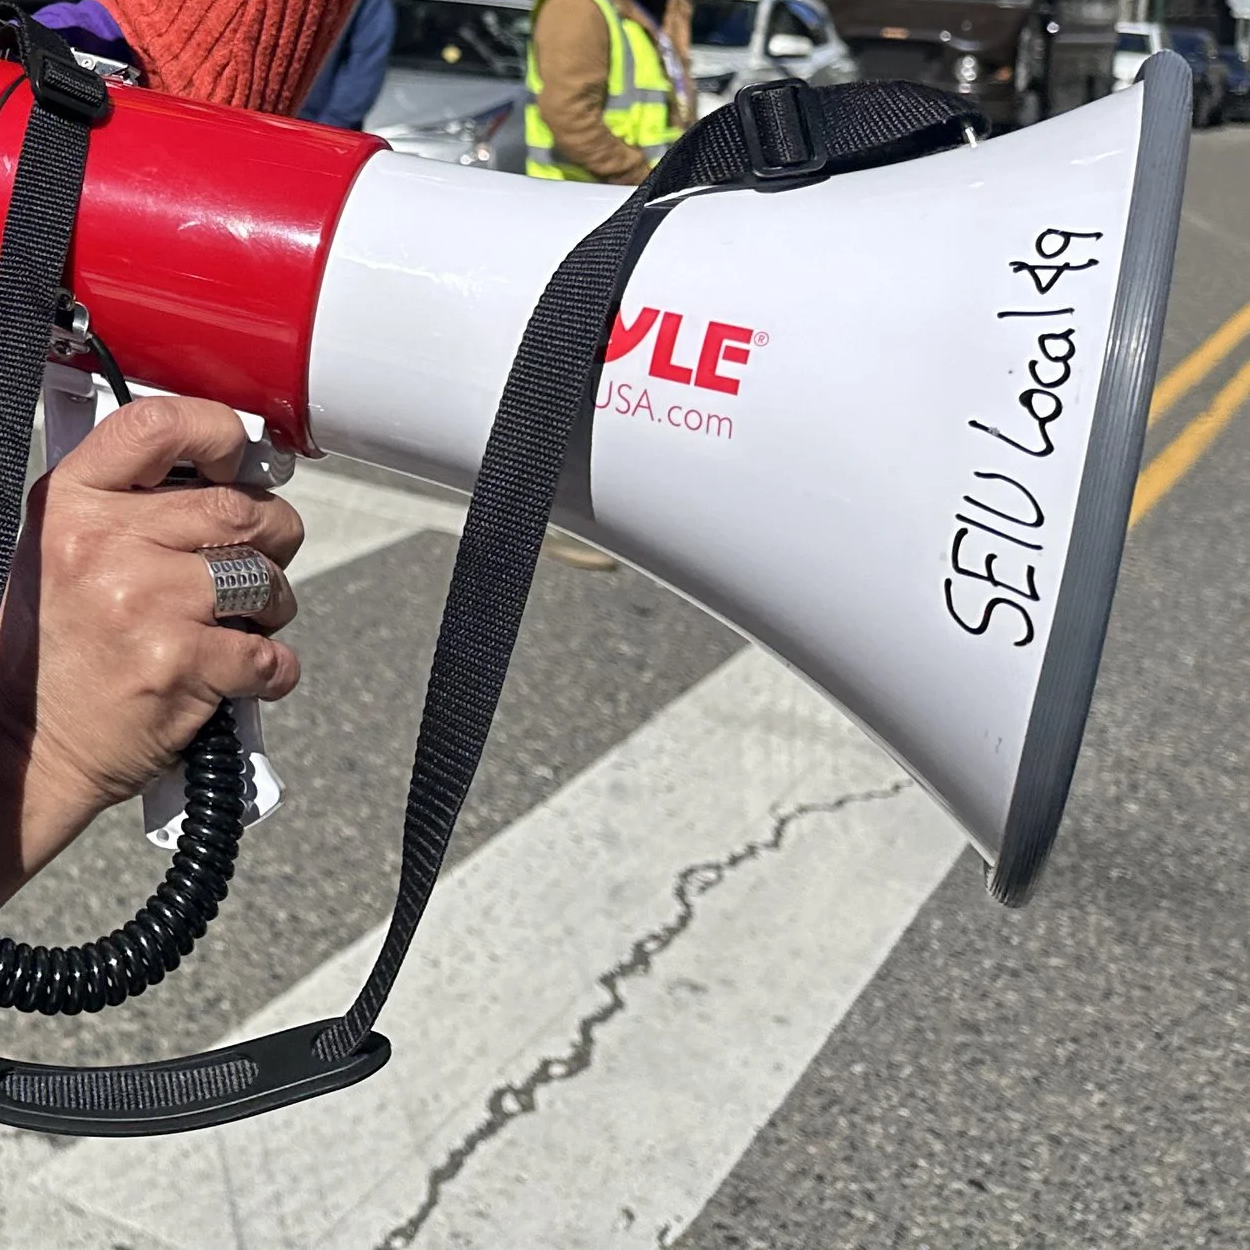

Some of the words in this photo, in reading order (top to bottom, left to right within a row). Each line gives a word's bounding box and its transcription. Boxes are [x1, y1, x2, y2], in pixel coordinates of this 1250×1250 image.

[1008, 228, 1104, 295] 49
[604, 306, 754, 397] YLE
[968, 307, 1076, 457] Local
[592, 376, 733, 439] USA.com
[944, 470, 1045, 647] SEIU
